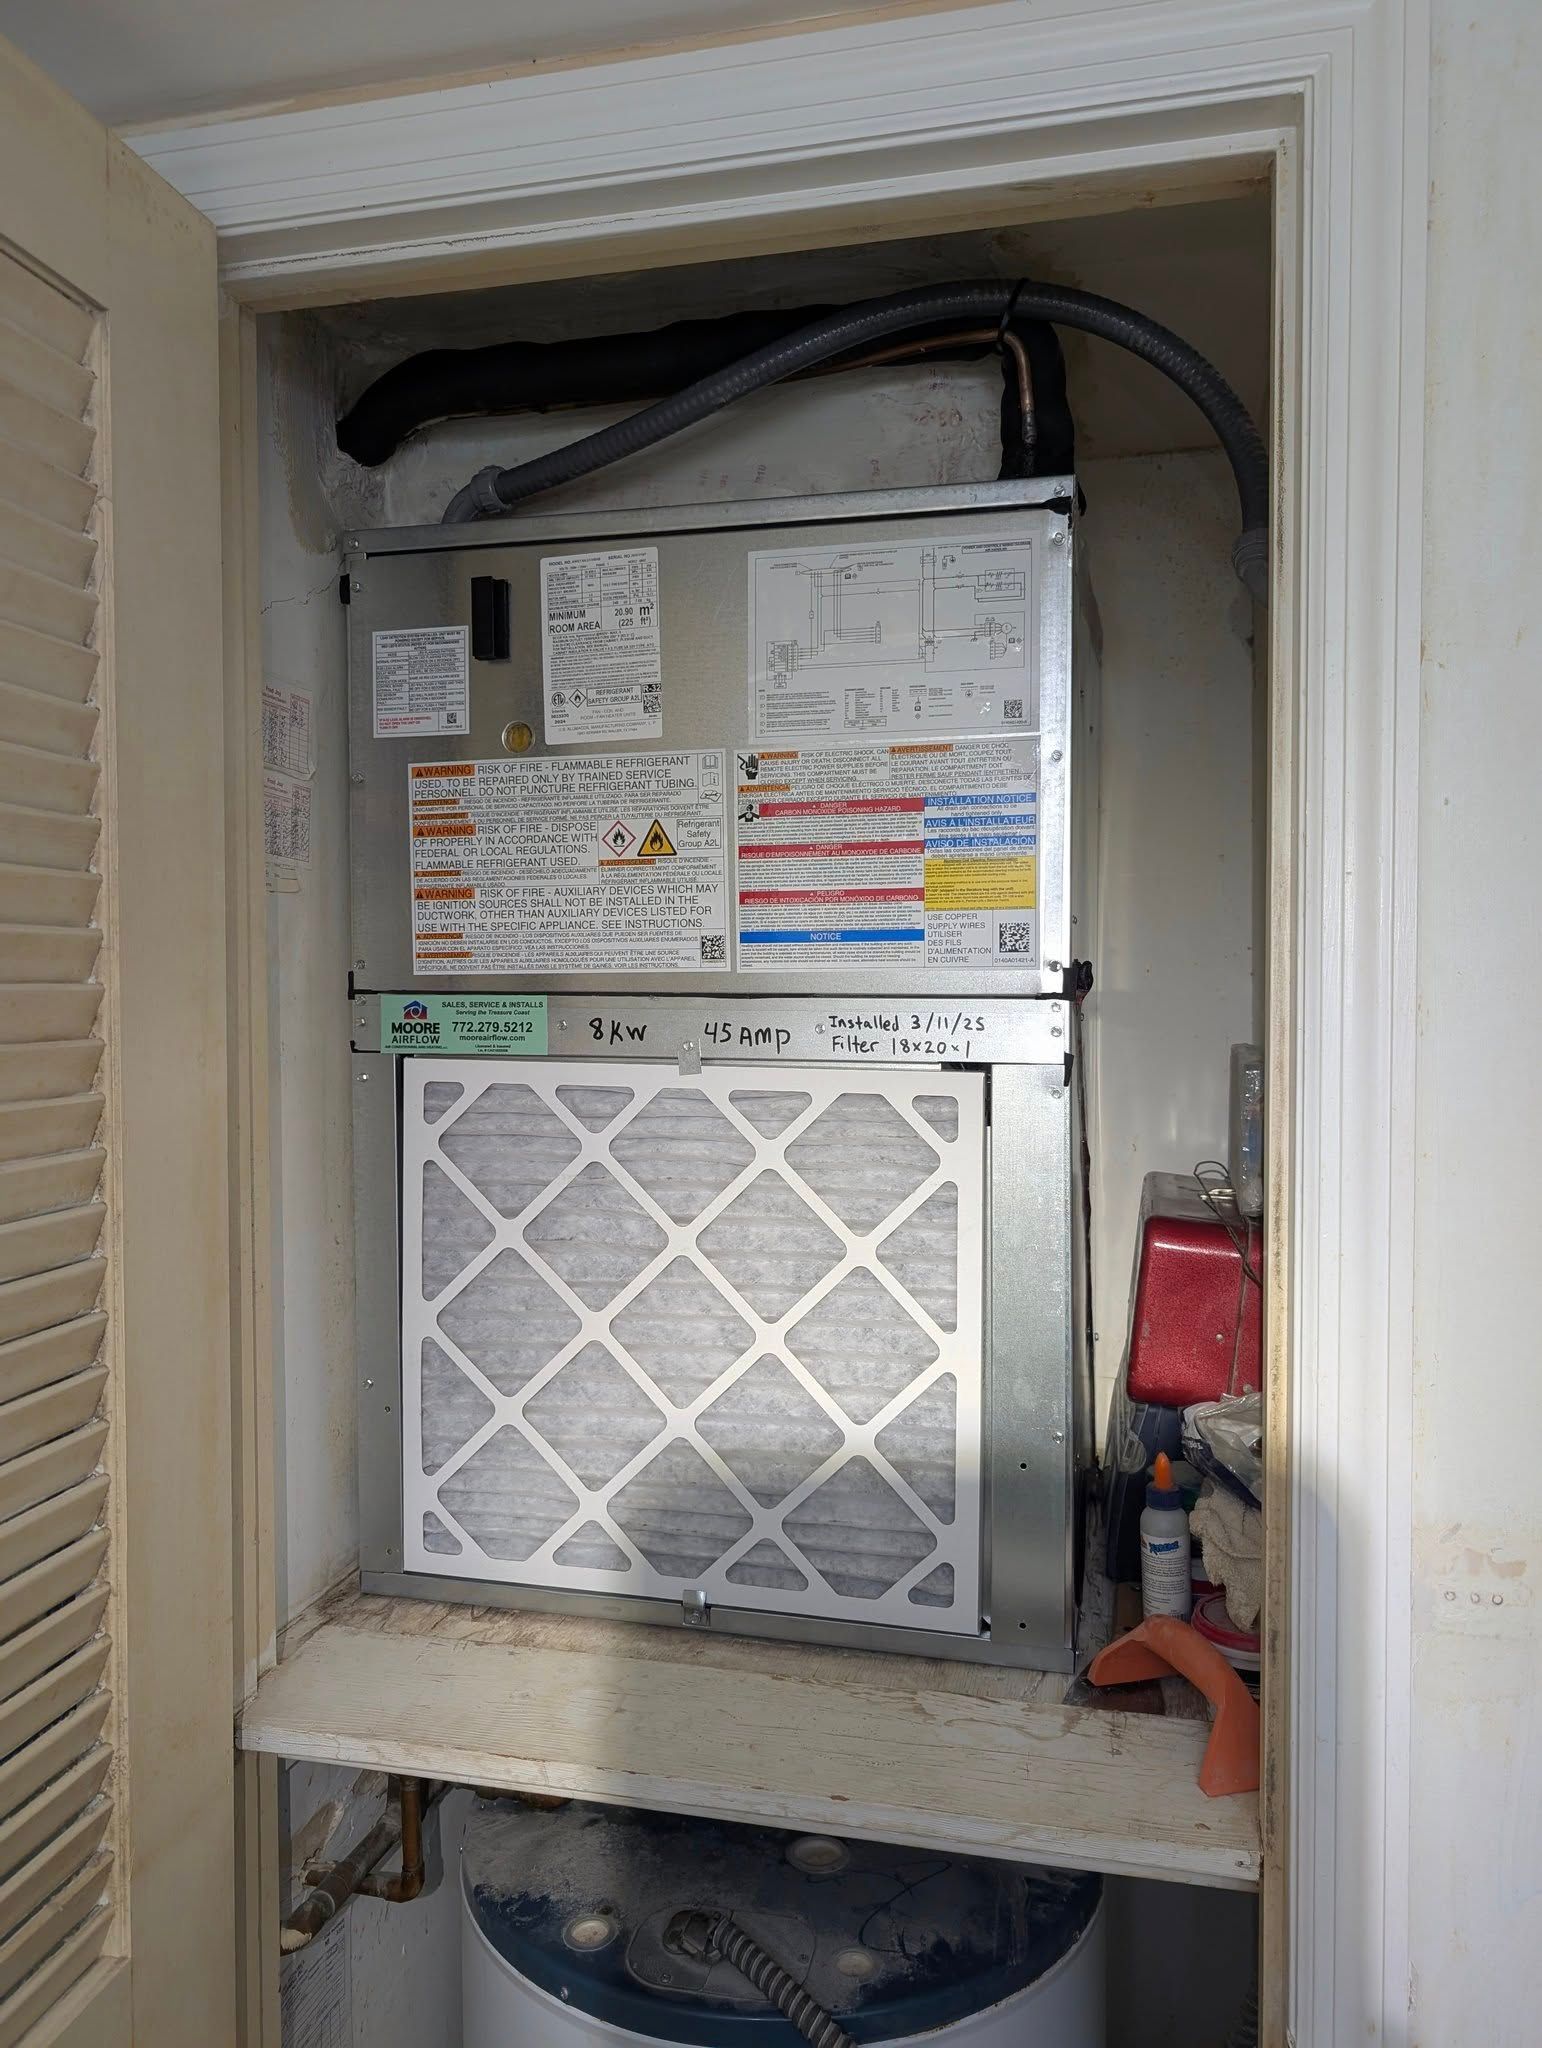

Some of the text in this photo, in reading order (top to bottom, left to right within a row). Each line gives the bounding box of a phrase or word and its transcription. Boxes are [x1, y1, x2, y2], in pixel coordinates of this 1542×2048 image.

[548, 610, 586, 621] MINIMUM
[614, 607, 634, 616] 20.90
[549, 624, 575, 634] ROOM
[577, 621, 600, 631] AREA
[618, 618, 634, 628] (225
[596, 687, 634, 696] REFRIGERANT
[424, 765, 472, 777] WARNING
[478, 765, 500, 775] RISK
[502, 764, 516, 774] OF
[519, 763, 542, 773] FIRE
[551, 760, 612, 772] FLAMMABLE
[615, 756, 690, 769] REFRIGERANT
[414, 769, 671, 789] USED. TO BE REPAIRED ONLY BY TRAINED SERVICE
[414, 778, 697, 798] PERSONNEL. DO NOT PUNCTURE REFRIGERANT TUBING.
[927, 794, 1032, 806] INSTALLATION NOTICE
[426, 825, 474, 836] WARNING
[478, 825, 500, 835] RISK
[502, 824, 516, 834] OF
[519, 824, 542, 833] FIRE
[550, 822, 596, 832] DISPOSE
[677, 820, 720, 829] Refrigerant
[925, 819, 947, 828] AVIS
[414, 833, 598, 848] OF PROPERLY IN ACCORDANCE WITH
[686, 830, 712, 839] Safety
[678, 838, 719, 848] Group A2L
[415, 844, 590, 858] FEDERAL OR LOCAL REGULATIONS.
[415, 857, 580, 870] FLAMMABLE REFRIGERANT USED.
[426, 889, 472, 898] WARNING
[480, 888, 503, 898] RISK
[505, 888, 519, 898] OF
[522, 887, 545, 897] FIRE
[553, 886, 606, 896] AUXILIARY
[609, 885, 654, 895] DEVICES
[656, 884, 692, 894] WHICH
[695, 884, 718, 893] MAY
[417, 895, 699, 910] BE IGNITION SOURCES SHALL NOT BE INSTALLED IN THE
[417, 906, 712, 921] DUCTWORK, OTHER THAN AUXILIARY DEVICES LISTED FOR
[927, 913, 943, 921] USE
[417, 918, 704, 932] USE WITH THE SPECIFIC APPLIANCE. SEE INSTRUCTIONS.
[927, 922, 958, 930] SUPPLY
[927, 947, 992, 955] D'ALIMENTATION
[391, 1022, 440, 1034] MOORE
[452, 1022, 533, 1033] 772.279.5212
[828, 1014, 900, 1032] Installed
[391, 1035, 440, 1044] AIRFLOW
[704, 1022, 732, 1044] 45
[832, 1035, 880, 1054] Filter
